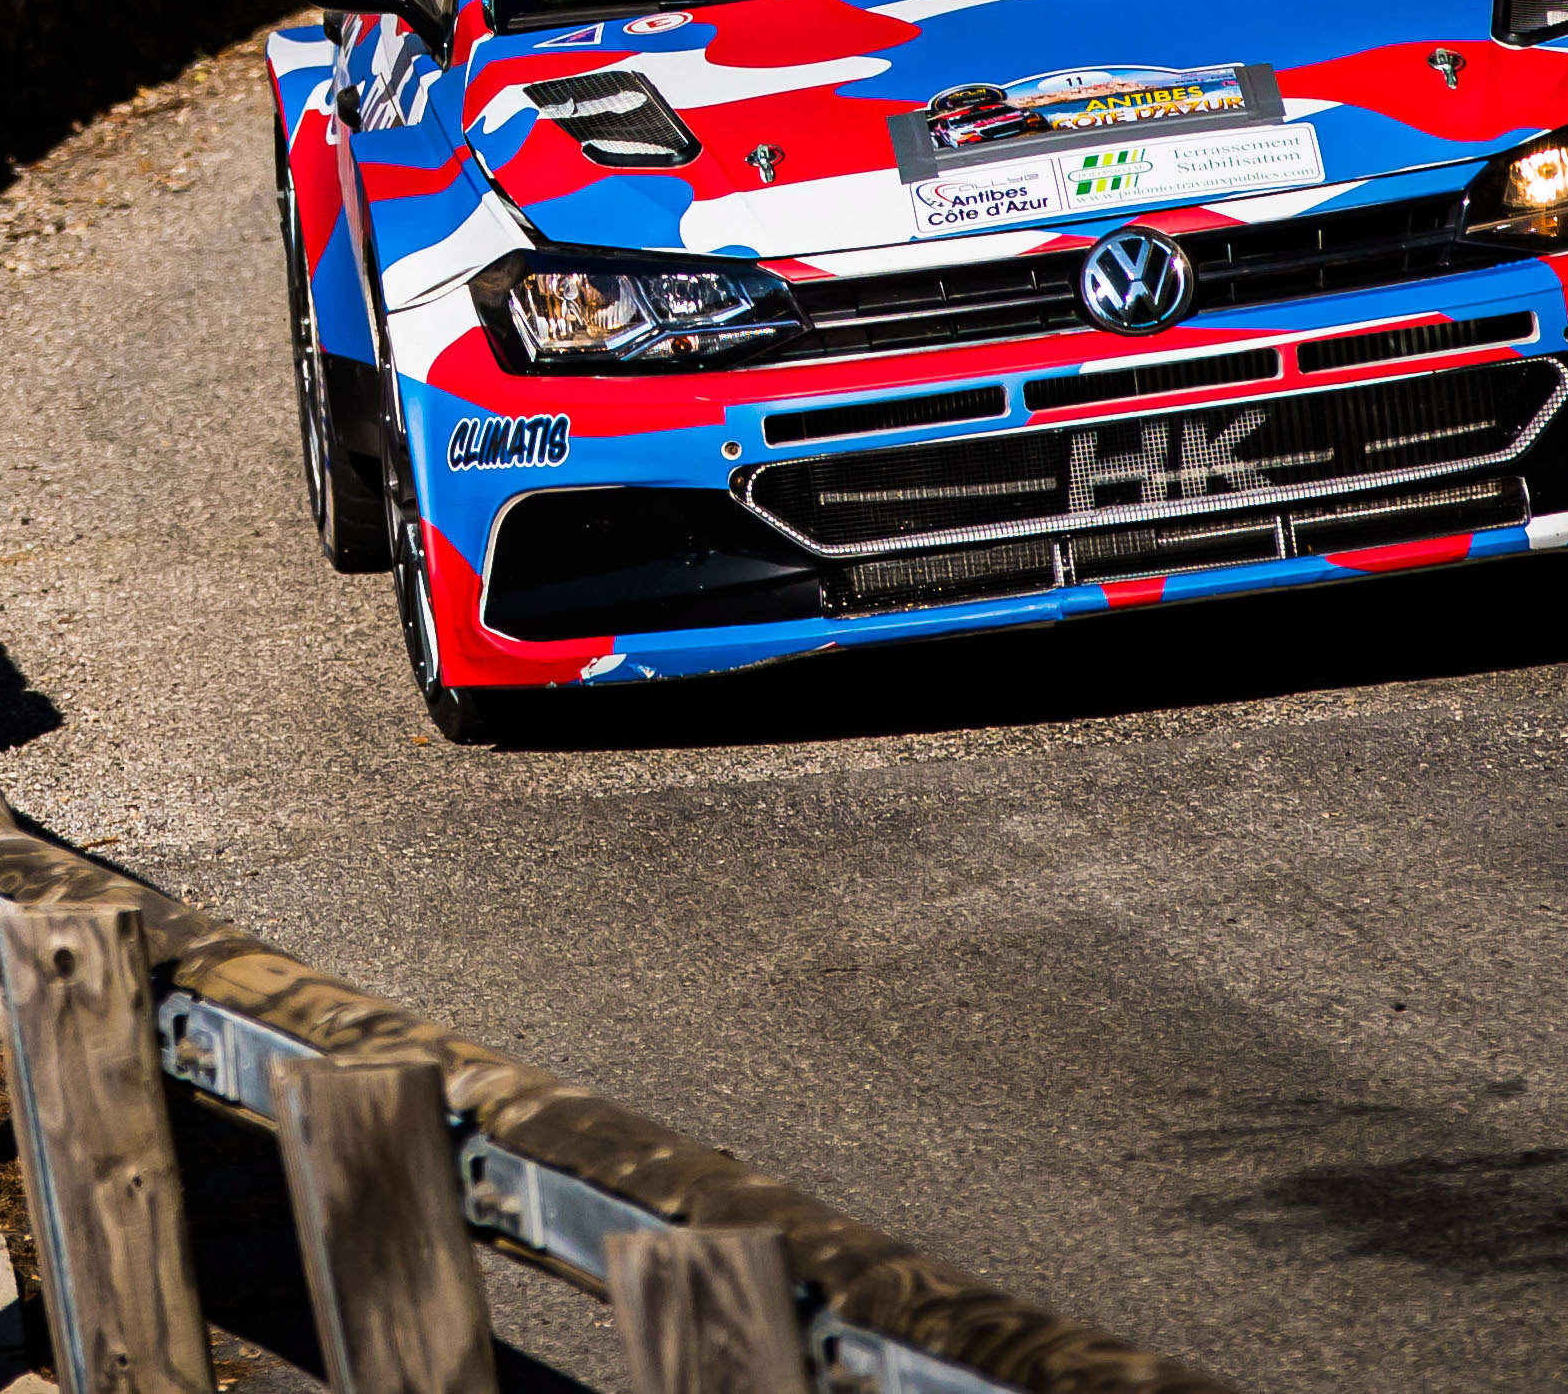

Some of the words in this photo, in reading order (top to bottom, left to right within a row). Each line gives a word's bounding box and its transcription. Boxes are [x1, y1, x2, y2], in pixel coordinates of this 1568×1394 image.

[1066, 76, 1083, 87] 11
[1085, 85, 1205, 112] ANTIBES
[1135, 96, 1244, 121] D'AZUR
[1169, 137, 1300, 159] Terrassement
[1177, 151, 1301, 174] Stabilisation
[952, 186, 1028, 208] Antibes
[928, 208, 979, 226] Côte
[986, 197, 1049, 217] d'Azur
[448, 414, 569, 470] CLIMATIS
[1069, 408, 1273, 513] HK
